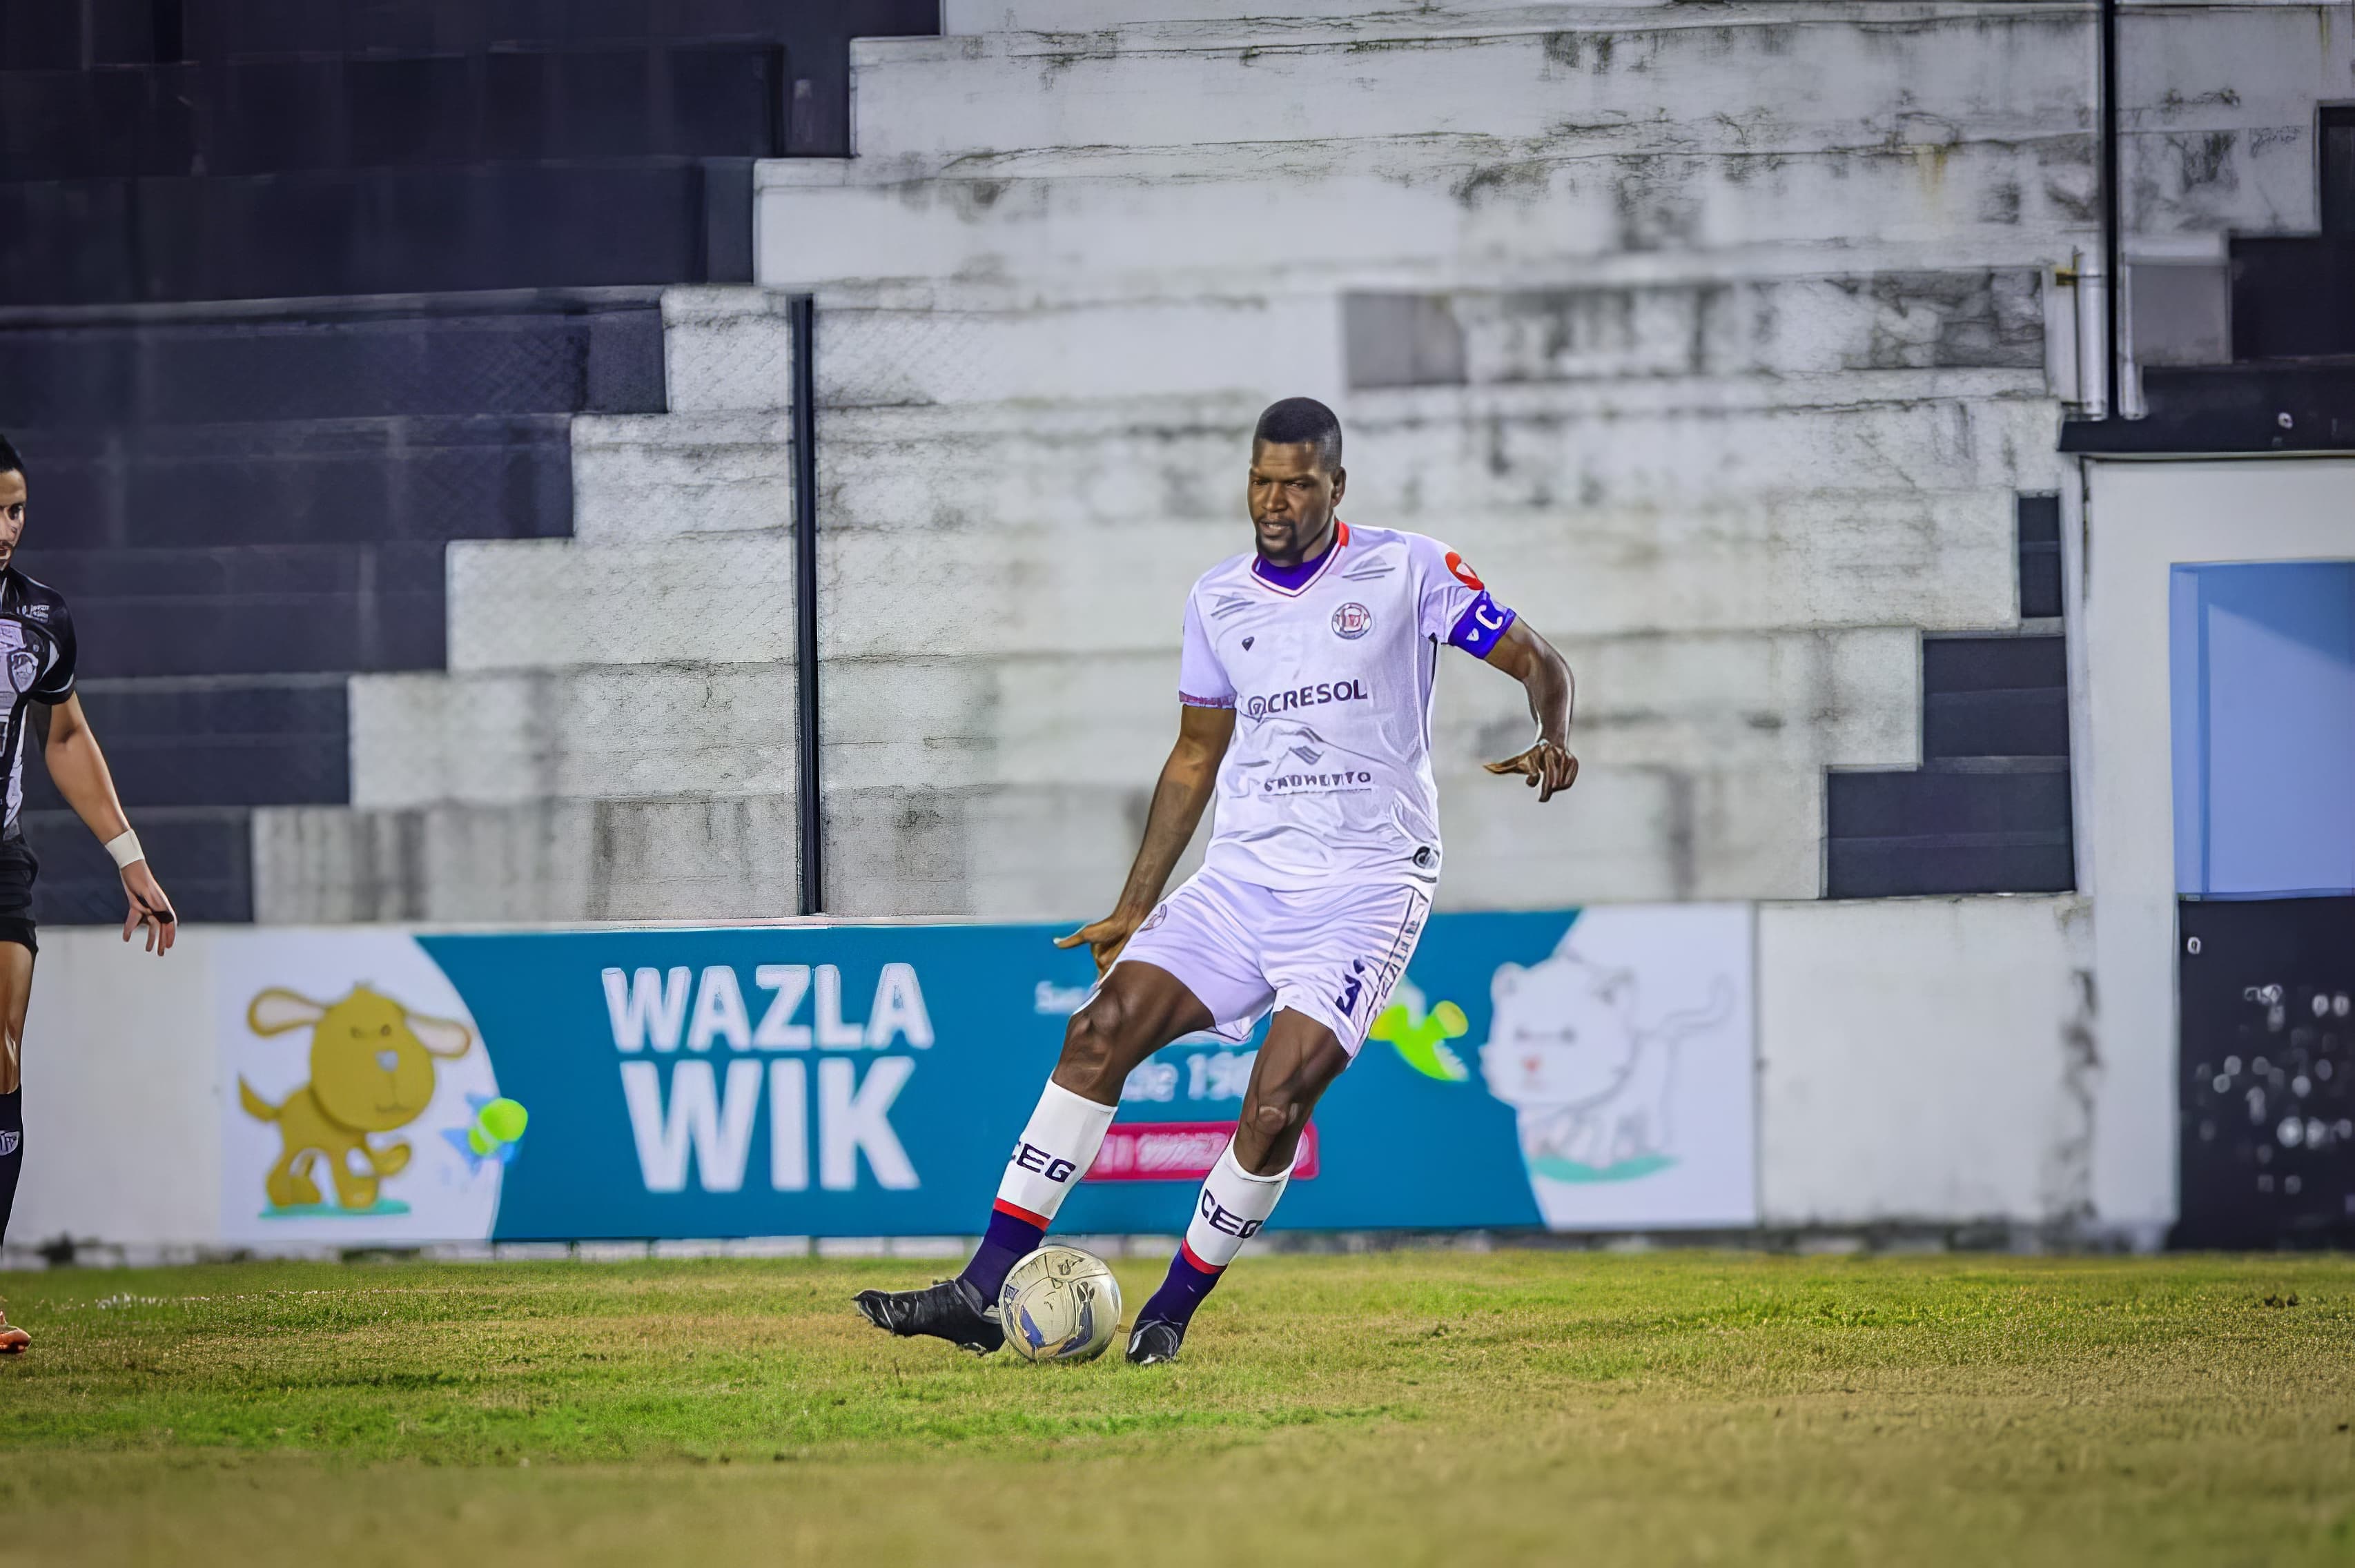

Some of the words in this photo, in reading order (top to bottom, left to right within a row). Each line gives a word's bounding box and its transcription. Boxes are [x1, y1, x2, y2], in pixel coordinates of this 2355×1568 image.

[1475, 605, 1503, 630] C
[1267, 679, 1368, 713] CRESOL
[601, 963, 935, 1052] WAZLA
[619, 1056, 921, 1193] WIK
[1011, 1141, 1077, 1184] EG
